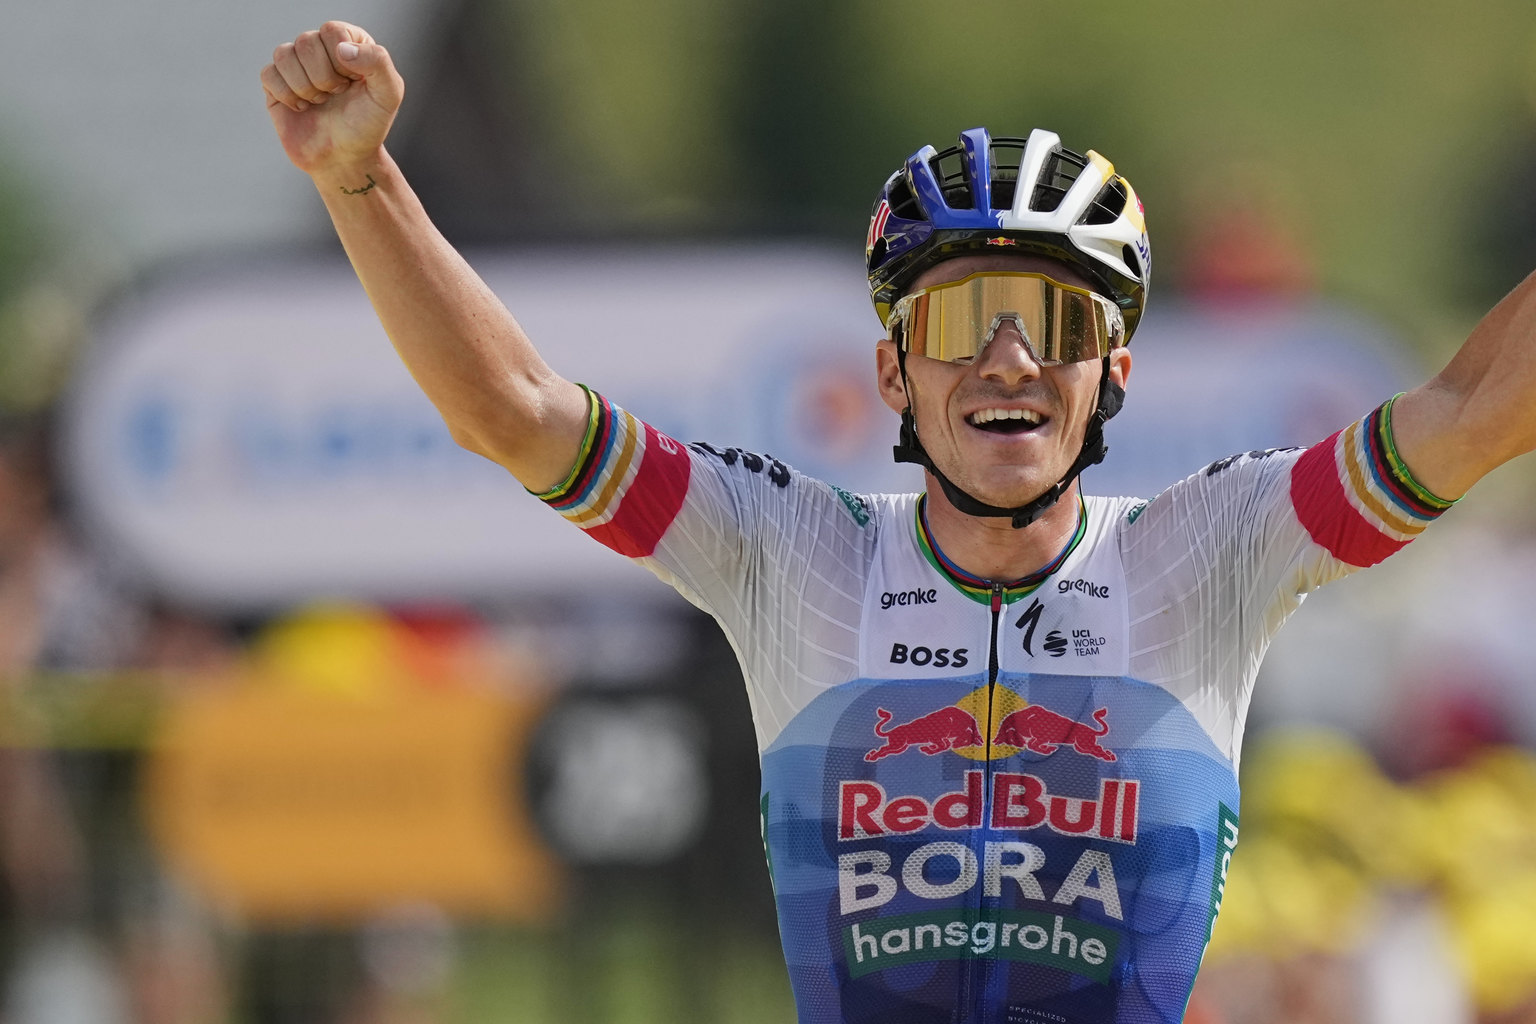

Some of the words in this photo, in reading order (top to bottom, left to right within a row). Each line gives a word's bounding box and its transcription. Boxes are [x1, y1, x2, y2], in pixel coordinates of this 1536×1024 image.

[880, 588, 937, 610] grenke
[1057, 578, 1110, 599] grenke
[1072, 629, 1091, 638] UCI
[1073, 637, 1106, 647] WORLD
[889, 643, 969, 668] BOSS
[1074, 648, 1100, 657] TEAM
[838, 769, 984, 842] Red
[989, 771, 1141, 845] Bull
[838, 841, 1123, 921] BORA
[851, 915, 1107, 965] hansgrohe
[1009, 1005, 1066, 1023] SPECIALIZED
